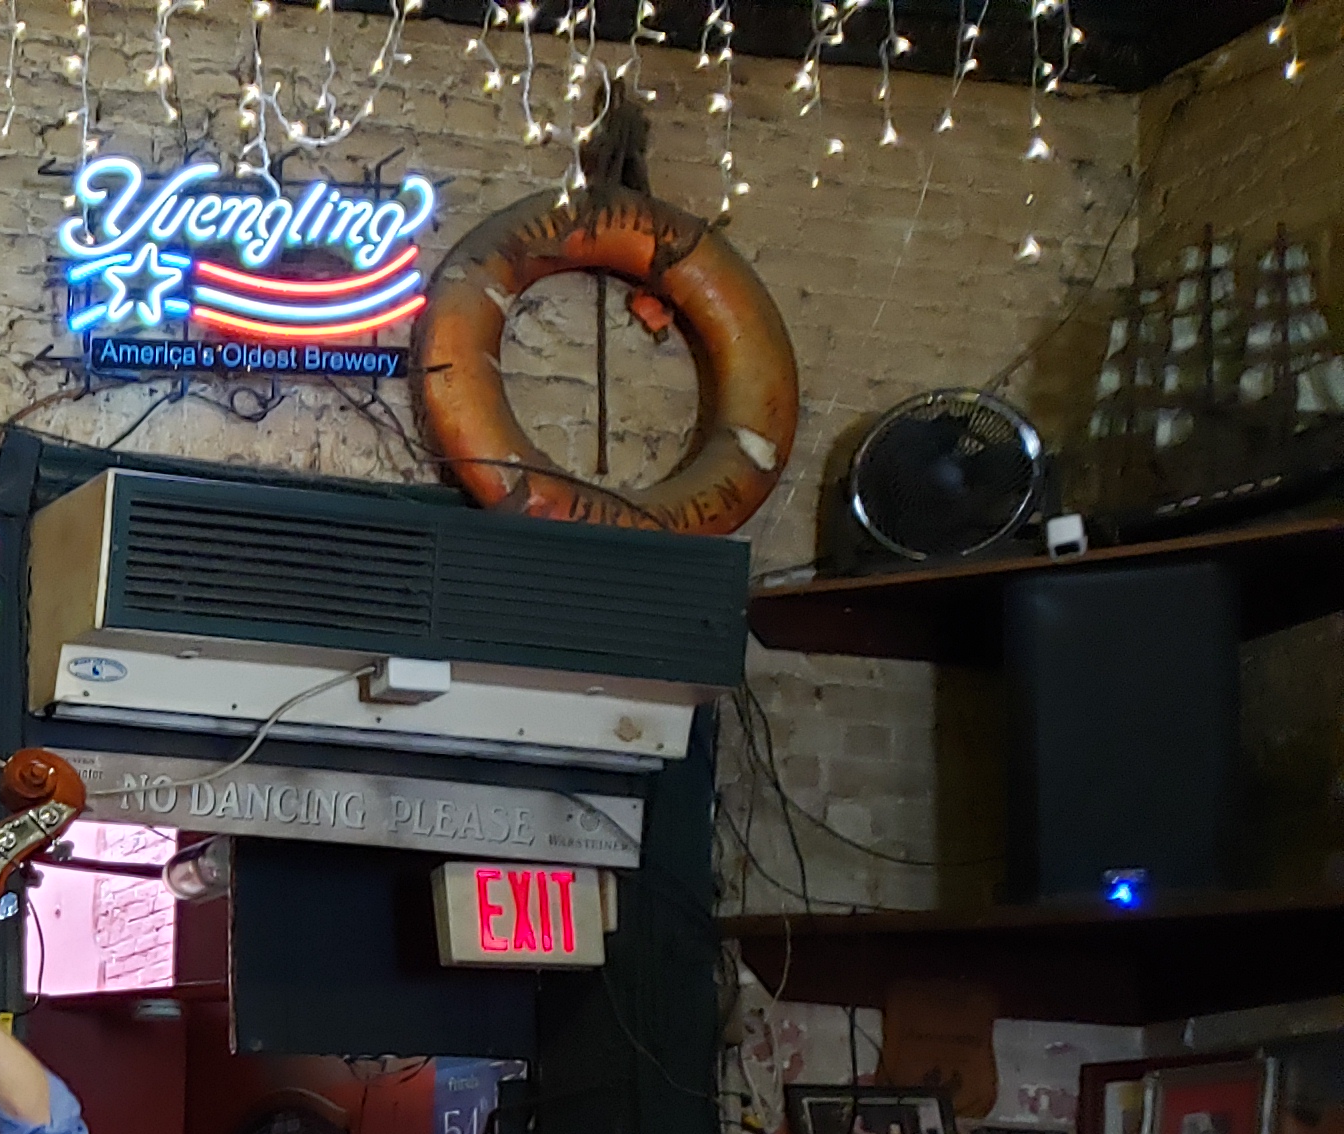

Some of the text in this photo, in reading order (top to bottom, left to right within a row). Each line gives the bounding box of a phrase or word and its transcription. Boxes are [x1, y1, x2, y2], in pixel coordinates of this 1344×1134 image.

[59, 156, 435, 268] Yuengling
[100, 337, 400, 374] America's Oldest Brewery
[119, 772, 536, 847] NO DANCING PLEASE
[473, 867, 578, 955] EXIT
